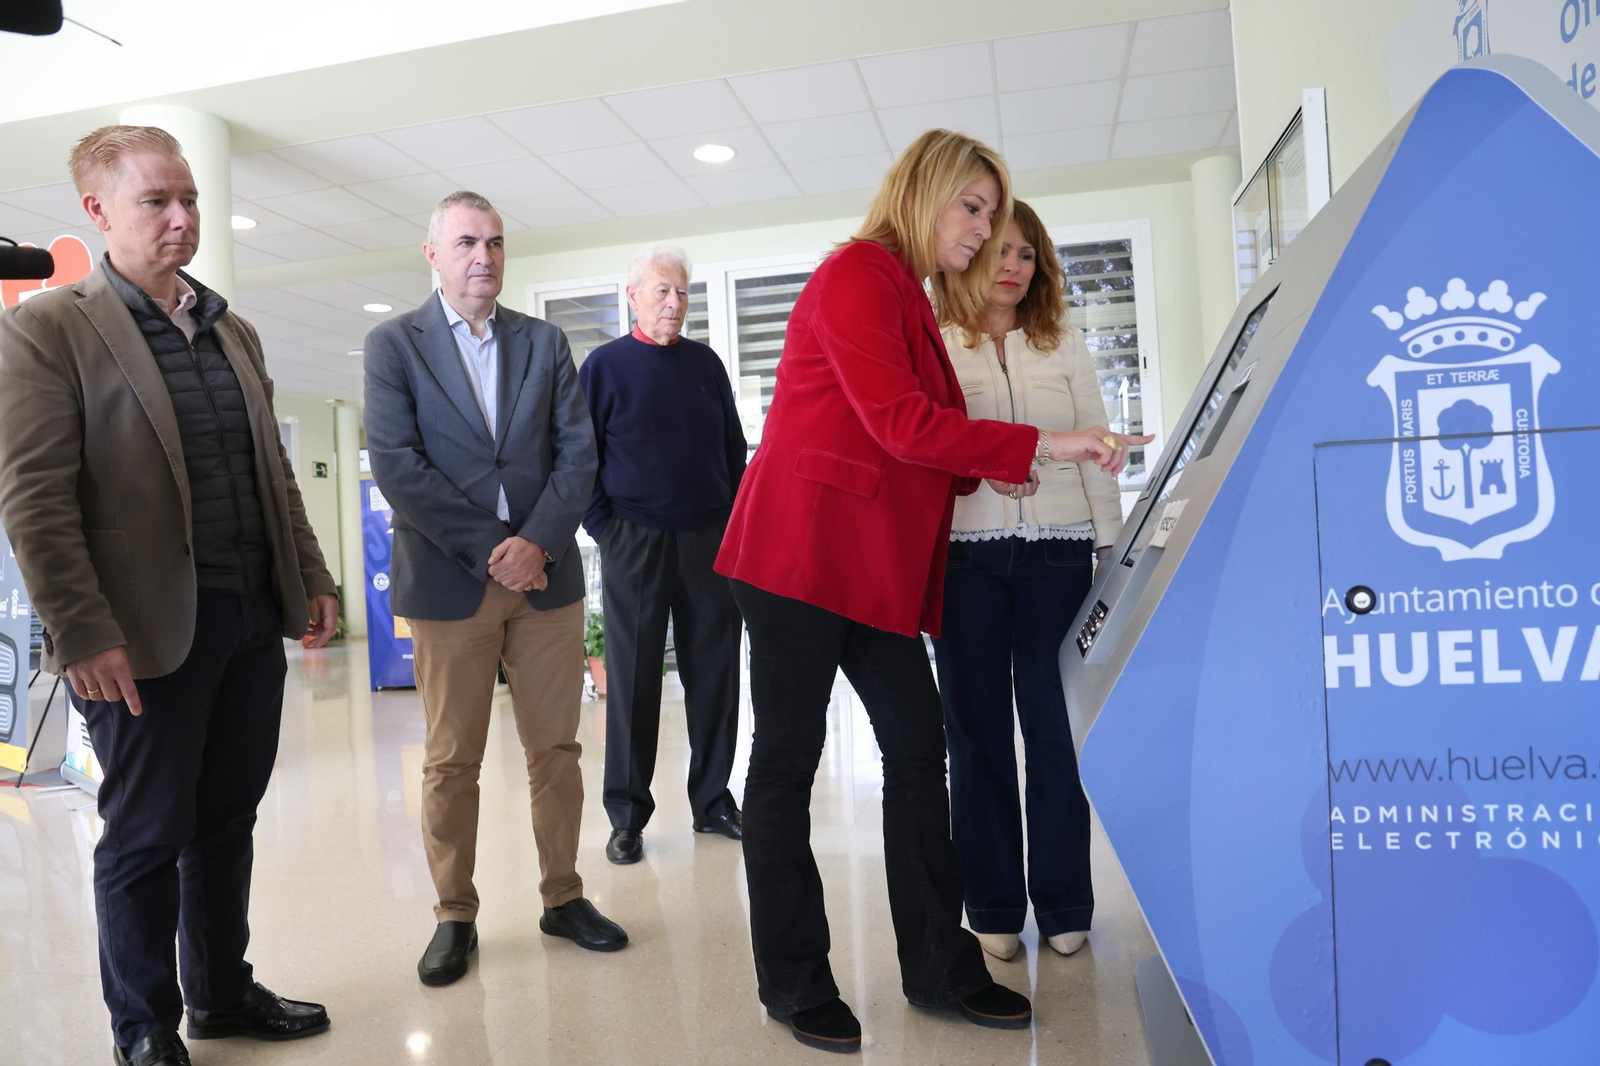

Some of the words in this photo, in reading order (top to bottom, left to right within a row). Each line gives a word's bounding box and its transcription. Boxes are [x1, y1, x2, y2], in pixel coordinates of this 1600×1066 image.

[1426, 373, 1444, 385] ET
[1515, 408, 1531, 479] CUSTODIA
[1403, 448, 1417, 503] PORTUS
[1329, 746, 1600, 783] www.huelva.
[1332, 827, 1600, 850] ELECTRÓNI
